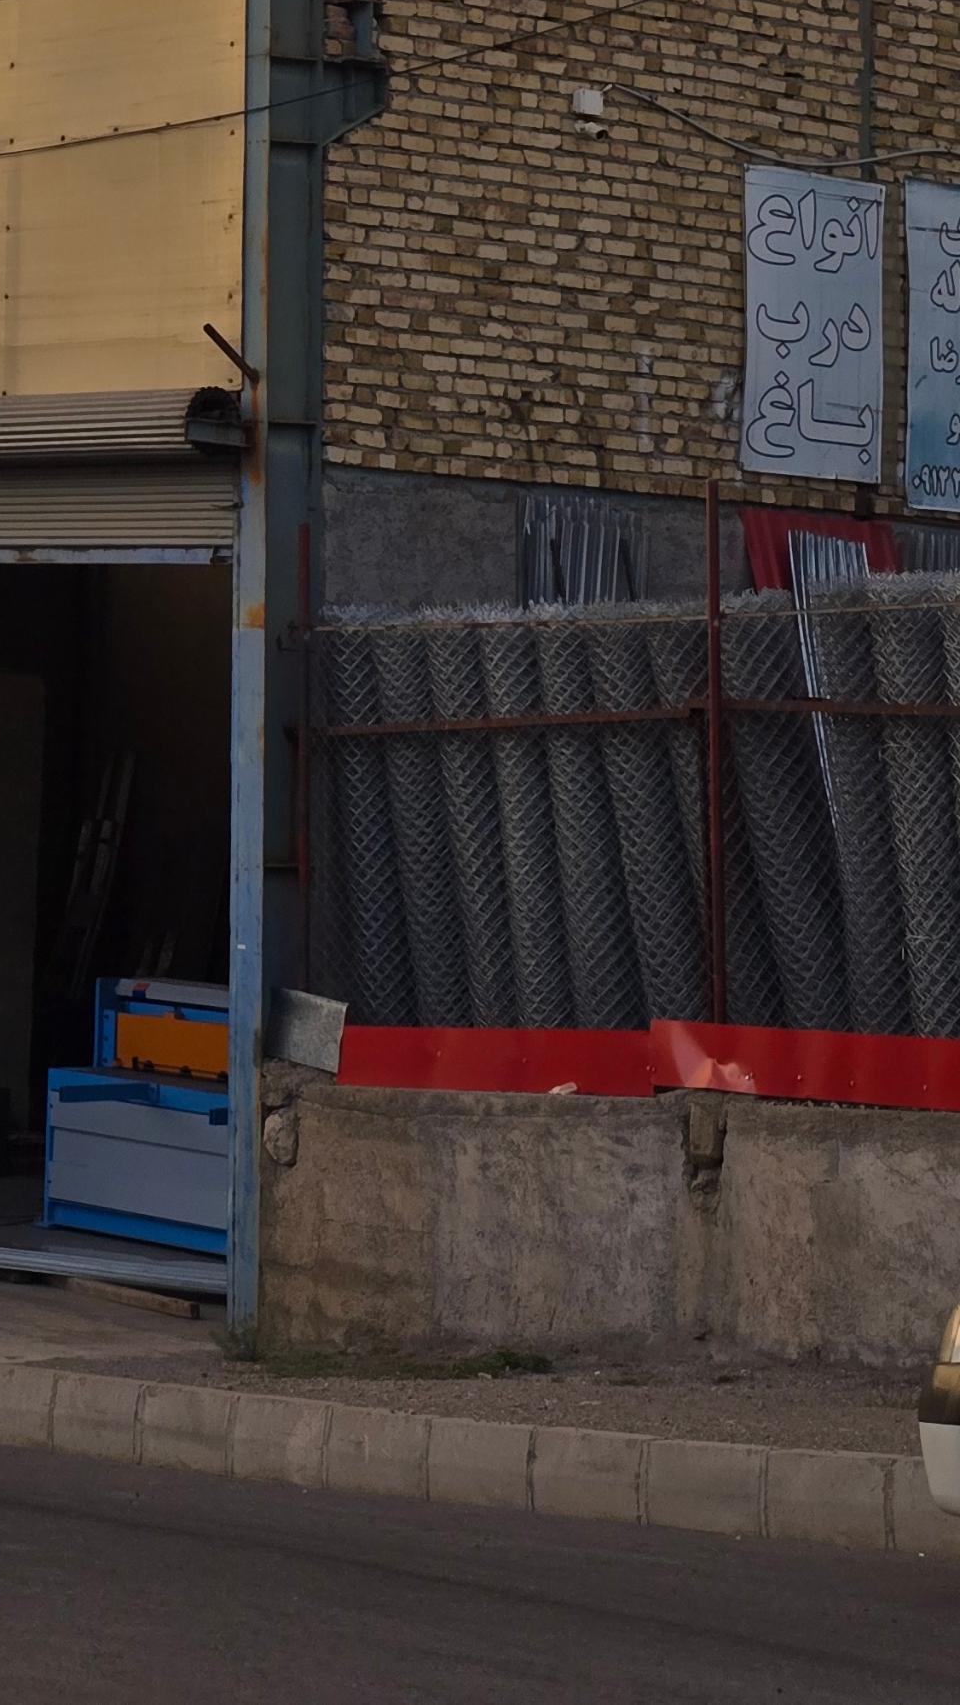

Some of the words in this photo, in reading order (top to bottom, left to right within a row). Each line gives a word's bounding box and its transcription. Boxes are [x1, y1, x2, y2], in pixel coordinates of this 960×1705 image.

[747, 189, 879, 273] انواع
[756, 301, 871, 368] درب
[746, 370, 874, 465] باغ
